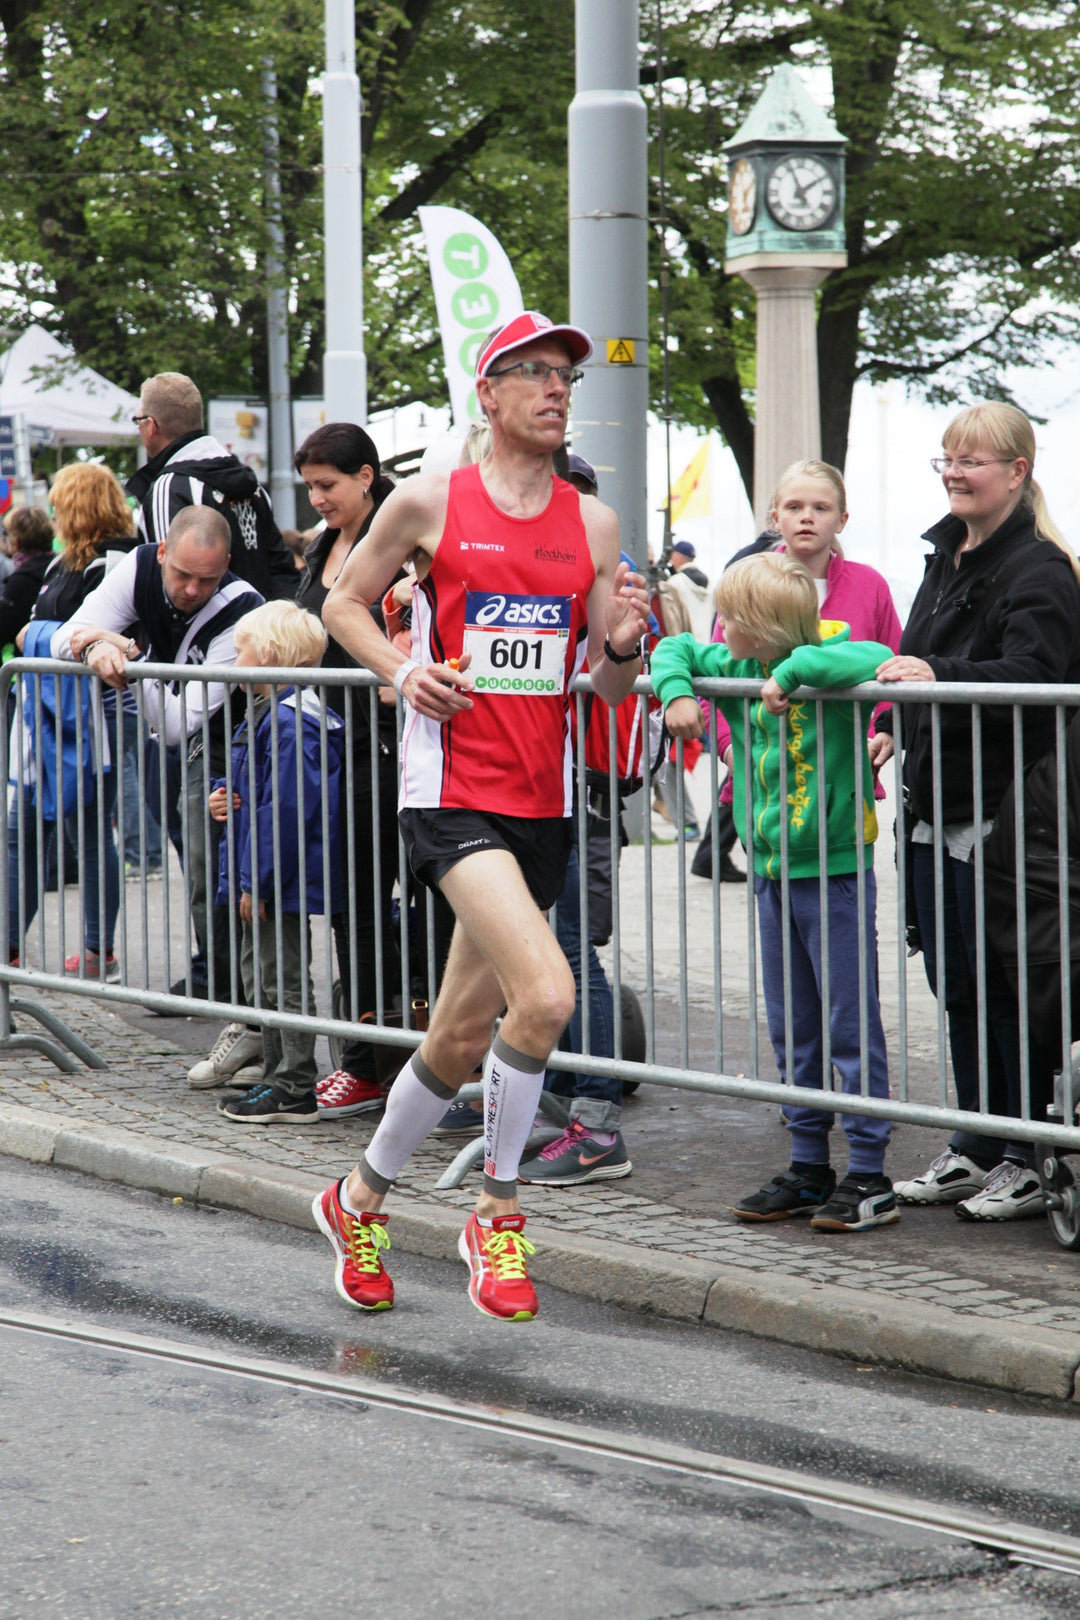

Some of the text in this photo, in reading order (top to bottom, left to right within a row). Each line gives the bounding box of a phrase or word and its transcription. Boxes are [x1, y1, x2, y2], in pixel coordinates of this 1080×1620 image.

[471, 542, 505, 552] TRIMTEX
[490, 638, 543, 670] 601
[487, 677, 555, 691] UNIBET
